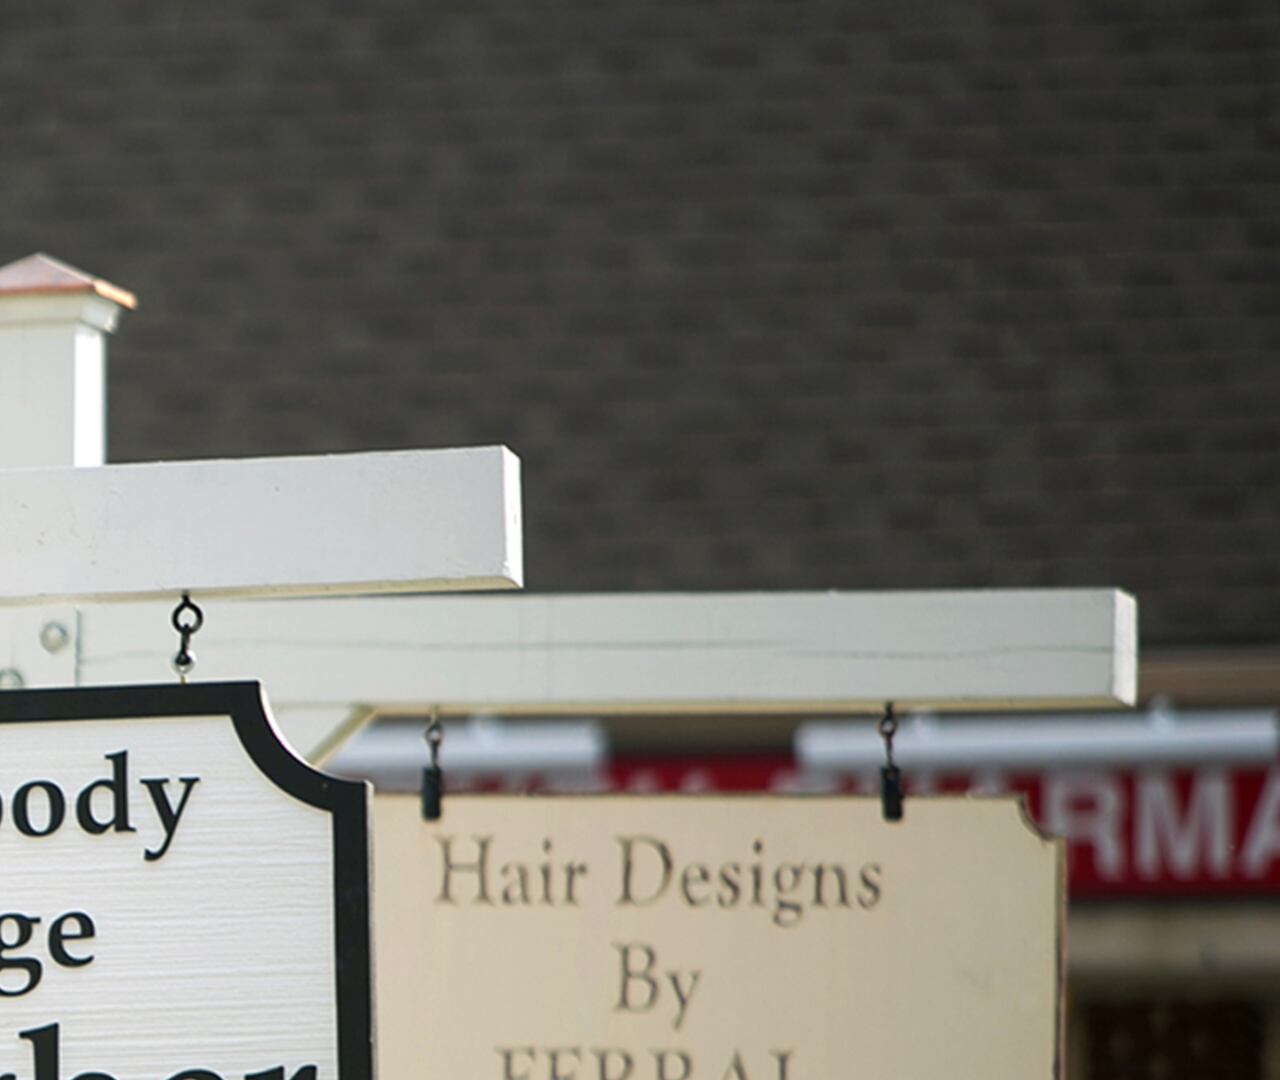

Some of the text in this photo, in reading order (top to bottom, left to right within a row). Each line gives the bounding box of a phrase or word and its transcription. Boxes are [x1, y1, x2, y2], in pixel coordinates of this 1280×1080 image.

[434, 835, 884, 926] Hair Designs
[612, 942, 702, 1030] By
